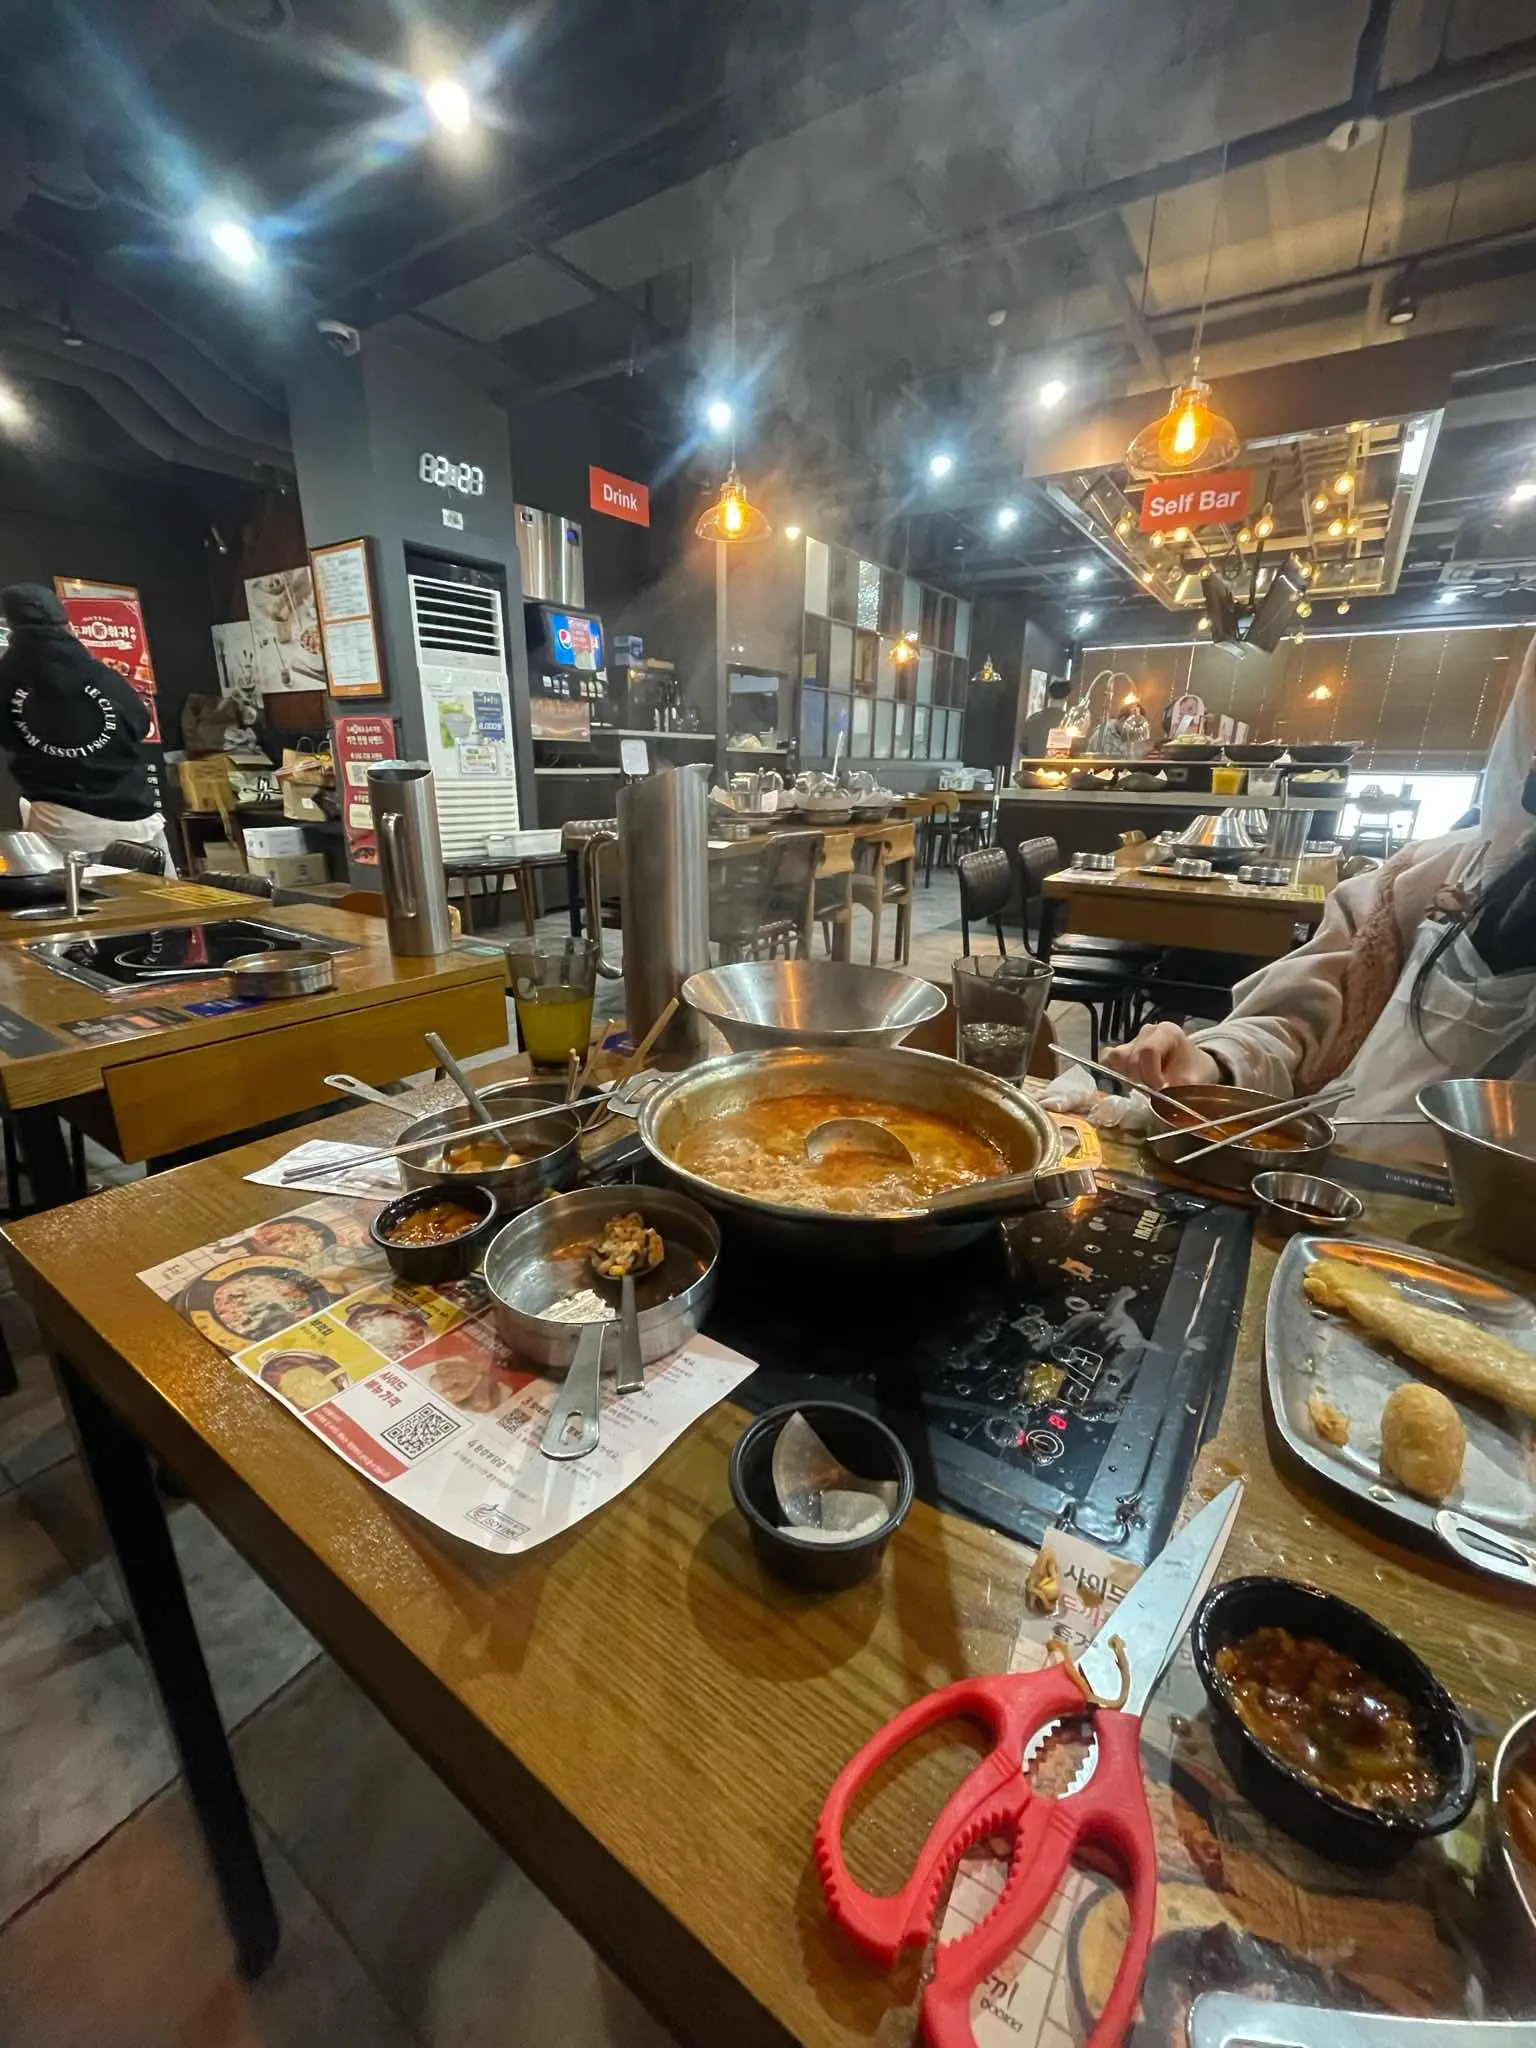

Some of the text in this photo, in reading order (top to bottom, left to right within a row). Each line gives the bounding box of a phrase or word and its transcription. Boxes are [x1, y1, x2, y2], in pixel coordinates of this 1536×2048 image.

[603, 483, 638, 512] Drink
[1149, 489, 1242, 517] Self Bar
[1063, 1564, 1128, 1604] 사이드
